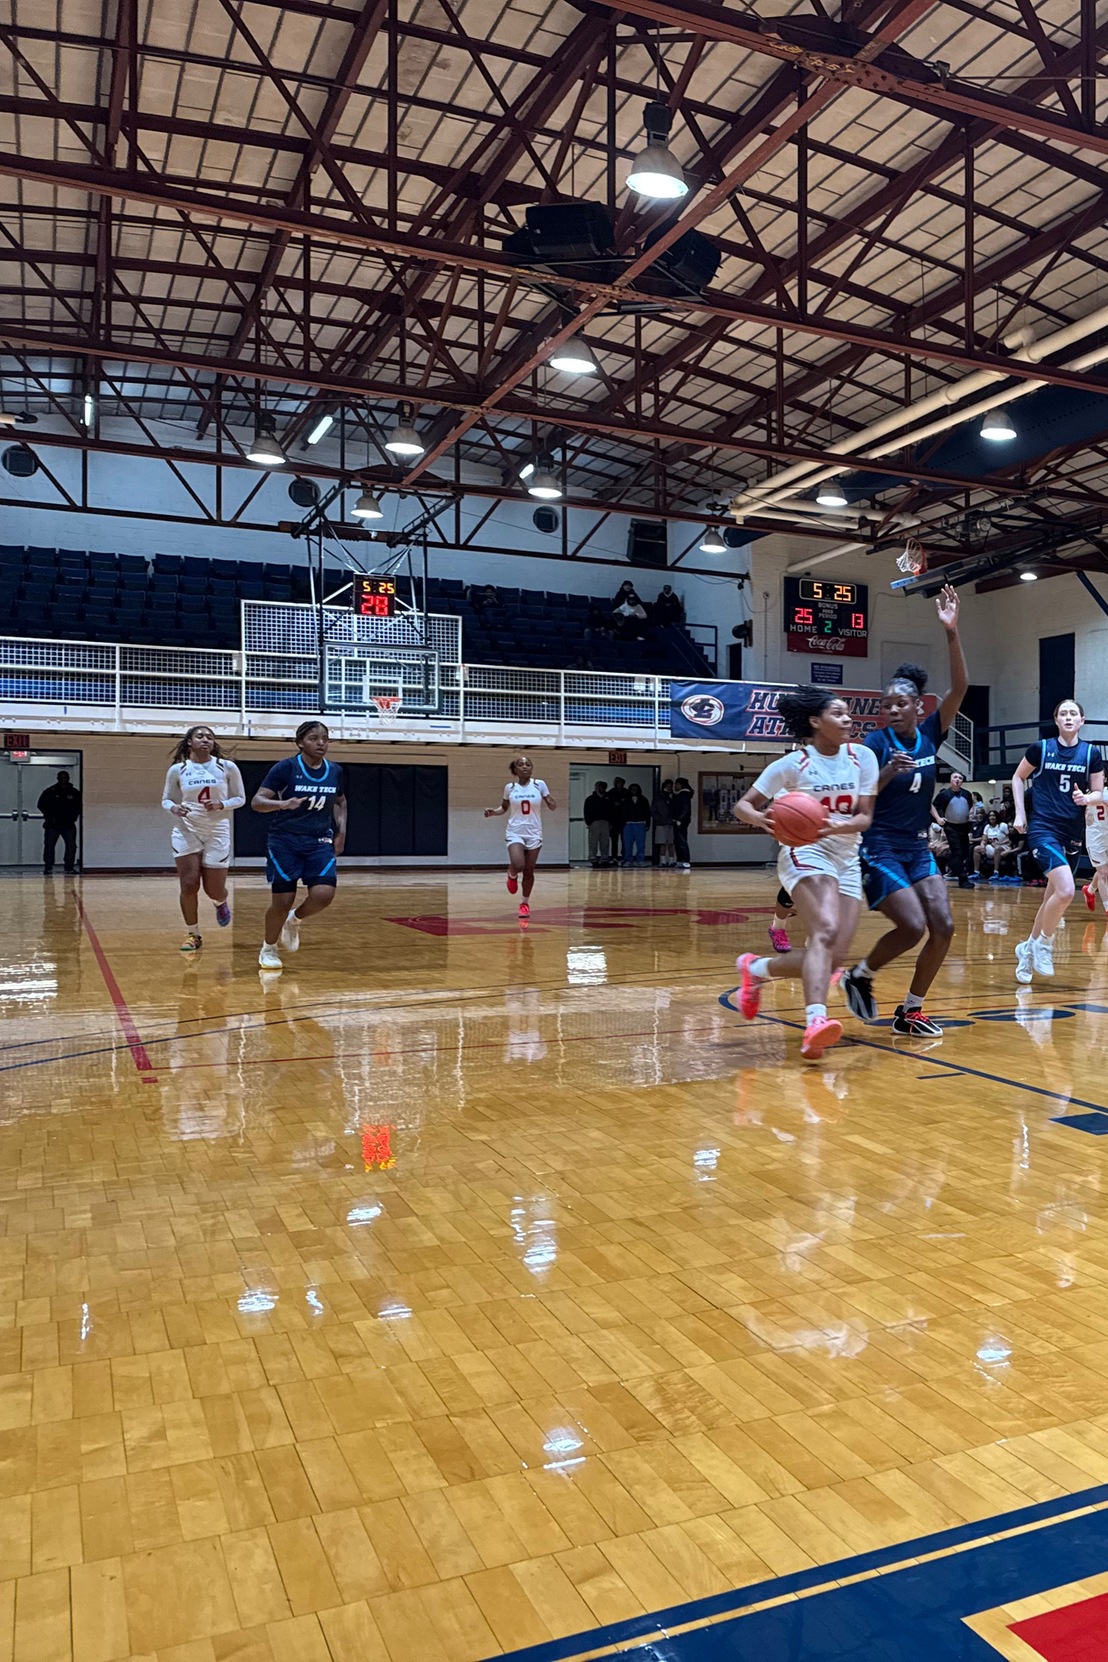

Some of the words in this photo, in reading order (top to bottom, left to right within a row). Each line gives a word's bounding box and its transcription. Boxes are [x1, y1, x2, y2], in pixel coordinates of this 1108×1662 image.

[795, 608, 812, 624] 25
[852, 613, 864, 628] 13
[790, 624, 818, 634] HOME
[838, 628, 868, 638] VISITOR
[824, 621, 832, 633] 2
[1044, 762, 1066, 771] WAKE
[1067, 764, 1086, 773] TECH
[813, 782, 855, 792] CANES
[909, 772, 922, 793] 4
[1059, 774, 1071, 792] 5
[307, 796, 326, 811] 14
[521, 800, 530, 815] 0
[1096, 805, 1105, 820] 2
